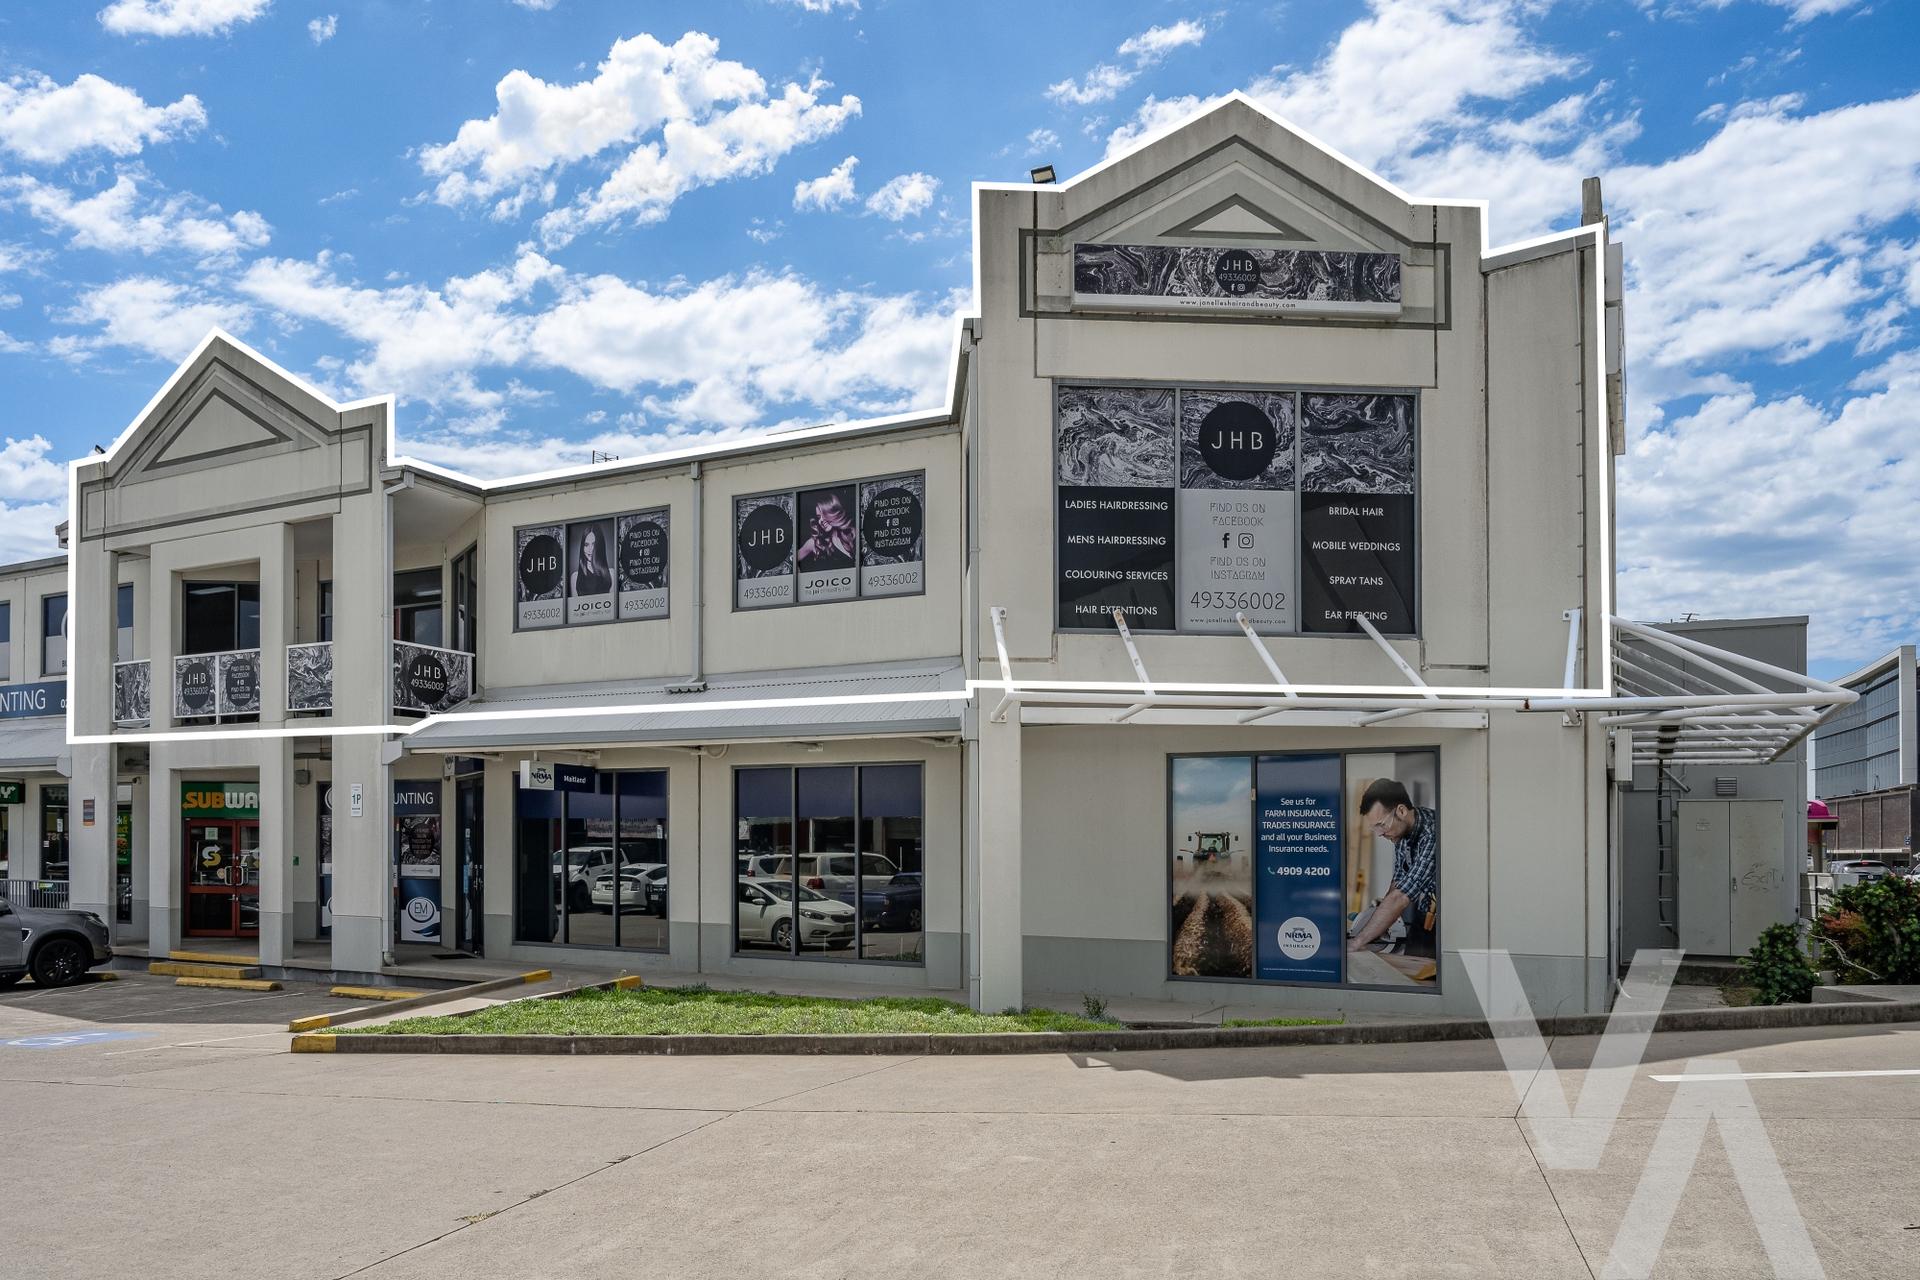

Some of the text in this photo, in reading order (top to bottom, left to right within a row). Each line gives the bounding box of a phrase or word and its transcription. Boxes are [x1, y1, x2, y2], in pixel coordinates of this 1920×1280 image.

[1219, 273, 1257, 282] 49336002
[1065, 500, 1168, 511] LADIES HAIRDRESSING
[1210, 502, 1266, 514] FIND US ON
[875, 507, 910, 517] FACEBOOK
[1329, 507, 1384, 516] BRIDAL HAIR
[1212, 516, 1264, 527] FACEBOOK
[1067, 535, 1167, 546] MENS HAIRDRESSING
[1312, 541, 1401, 551] MOBILE WEDDINGS
[1210, 556, 1266, 568] FIND US ON
[868, 572, 918, 587] 49336002
[1065, 570, 1168, 580] COLOURING SERVICES
[1211, 570, 1265, 580] INSTAGRAM
[805, 577, 851, 589] JOICO
[1329, 576, 1384, 586] SPRAY TANS
[743, 585, 790, 599] 49336002
[624, 598, 665, 611] 49336002
[1190, 591, 1286, 610] 49336002
[574, 600, 612, 612] JOICO
[1075, 605, 1097, 614] HAIR
[523, 608, 561, 620] 49336002
[1325, 610, 1342, 620] EAR
[411, 679, 445, 691] 49336002
[0, 689, 46, 713] NTING
[351, 794, 362, 805] 1P
[1280, 798, 1294, 806] See
[1305, 797, 1316, 806] for
[1265, 809, 1333, 818] FARM INSURANCE,
[1262, 821, 1336, 829] TRADES INSURANCE
[1261, 833, 1337, 842] and all your Business
[1268, 845, 1329, 853] Insurance needs.
[1277, 867, 1330, 876] 4909 4200
[1284, 932, 1313, 940] NRMA
